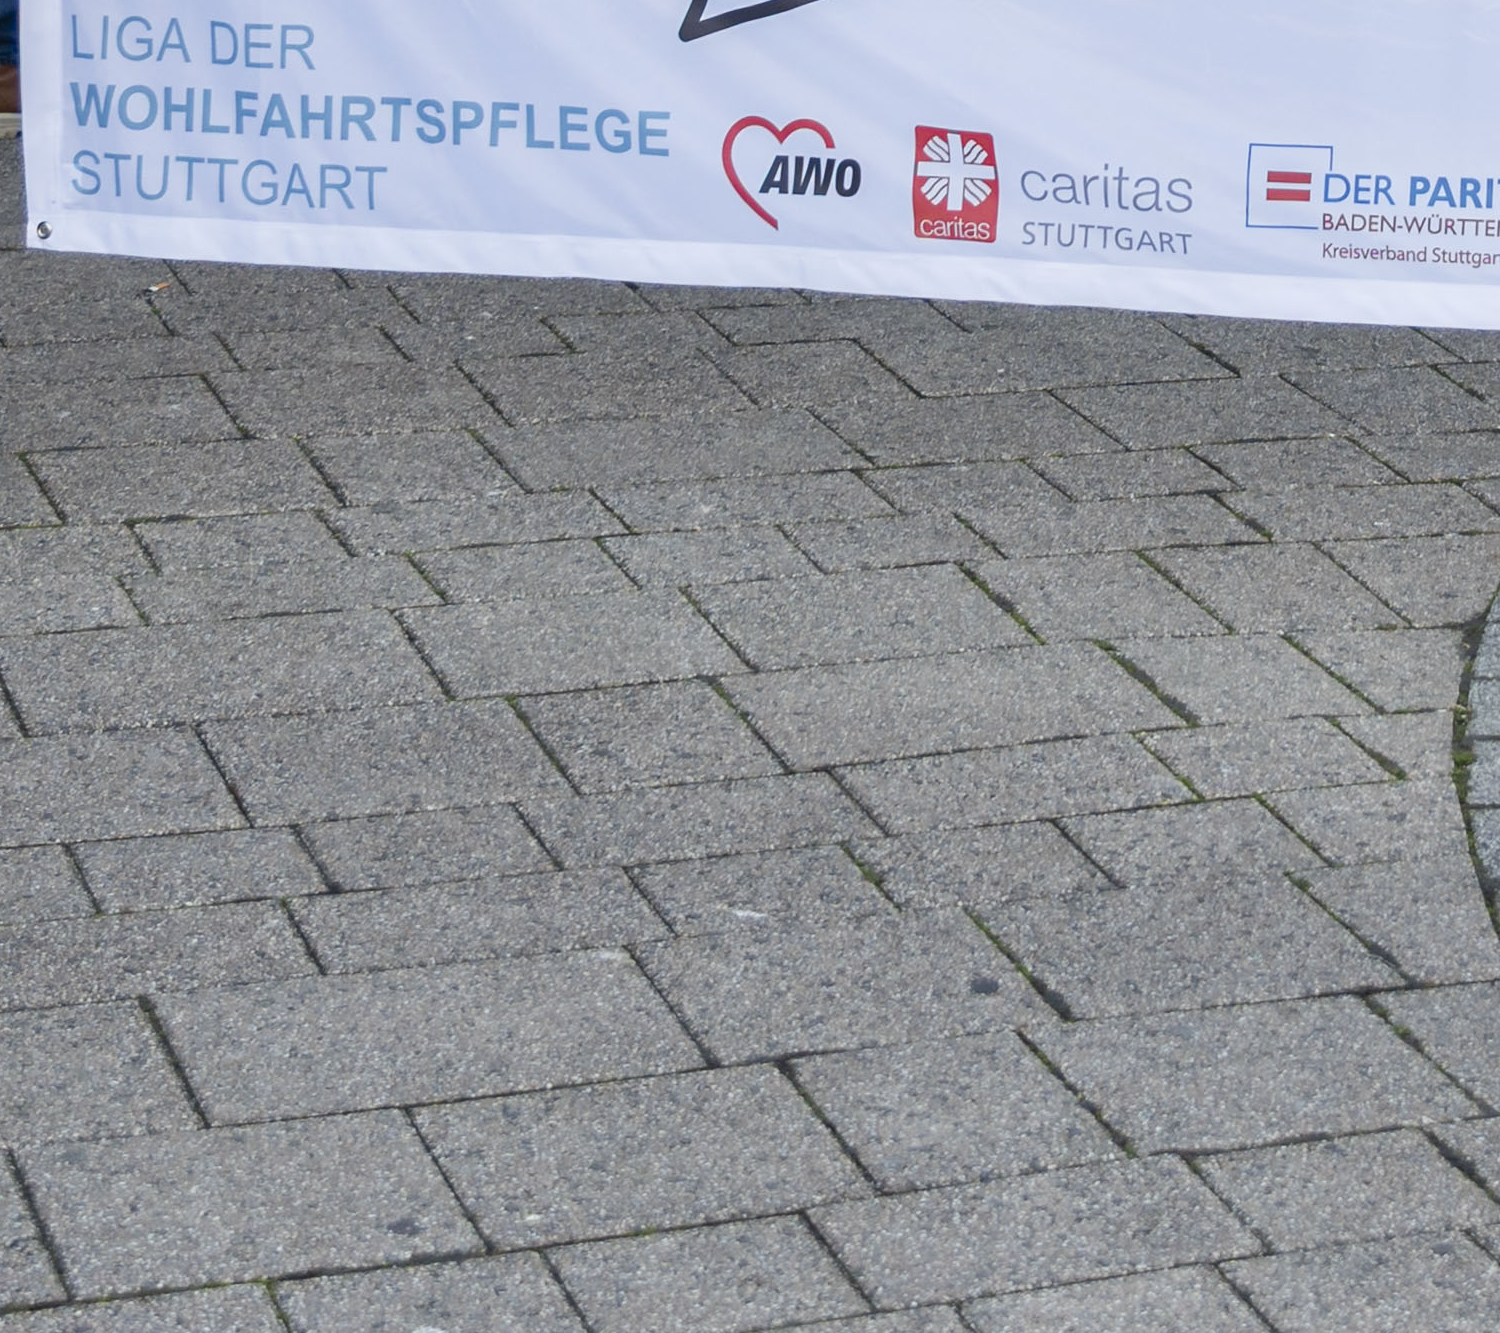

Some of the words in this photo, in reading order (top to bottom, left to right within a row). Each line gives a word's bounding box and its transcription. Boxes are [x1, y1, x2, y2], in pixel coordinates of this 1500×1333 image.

[70, 13, 191, 63] LIGA
[209, 20, 315, 70] DER
[69, 81, 670, 167] WOHLFAHRTSPFLEGE
[71, 149, 388, 211] STUTTGART
[759, 155, 862, 197] AWO
[1020, 163, 1193, 214] caritas
[1323, 173, 1395, 206] DER
[920, 216, 991, 241] caritas
[1022, 221, 1193, 255] STUTTGART
[1322, 243, 1427, 263] Kreisverband
